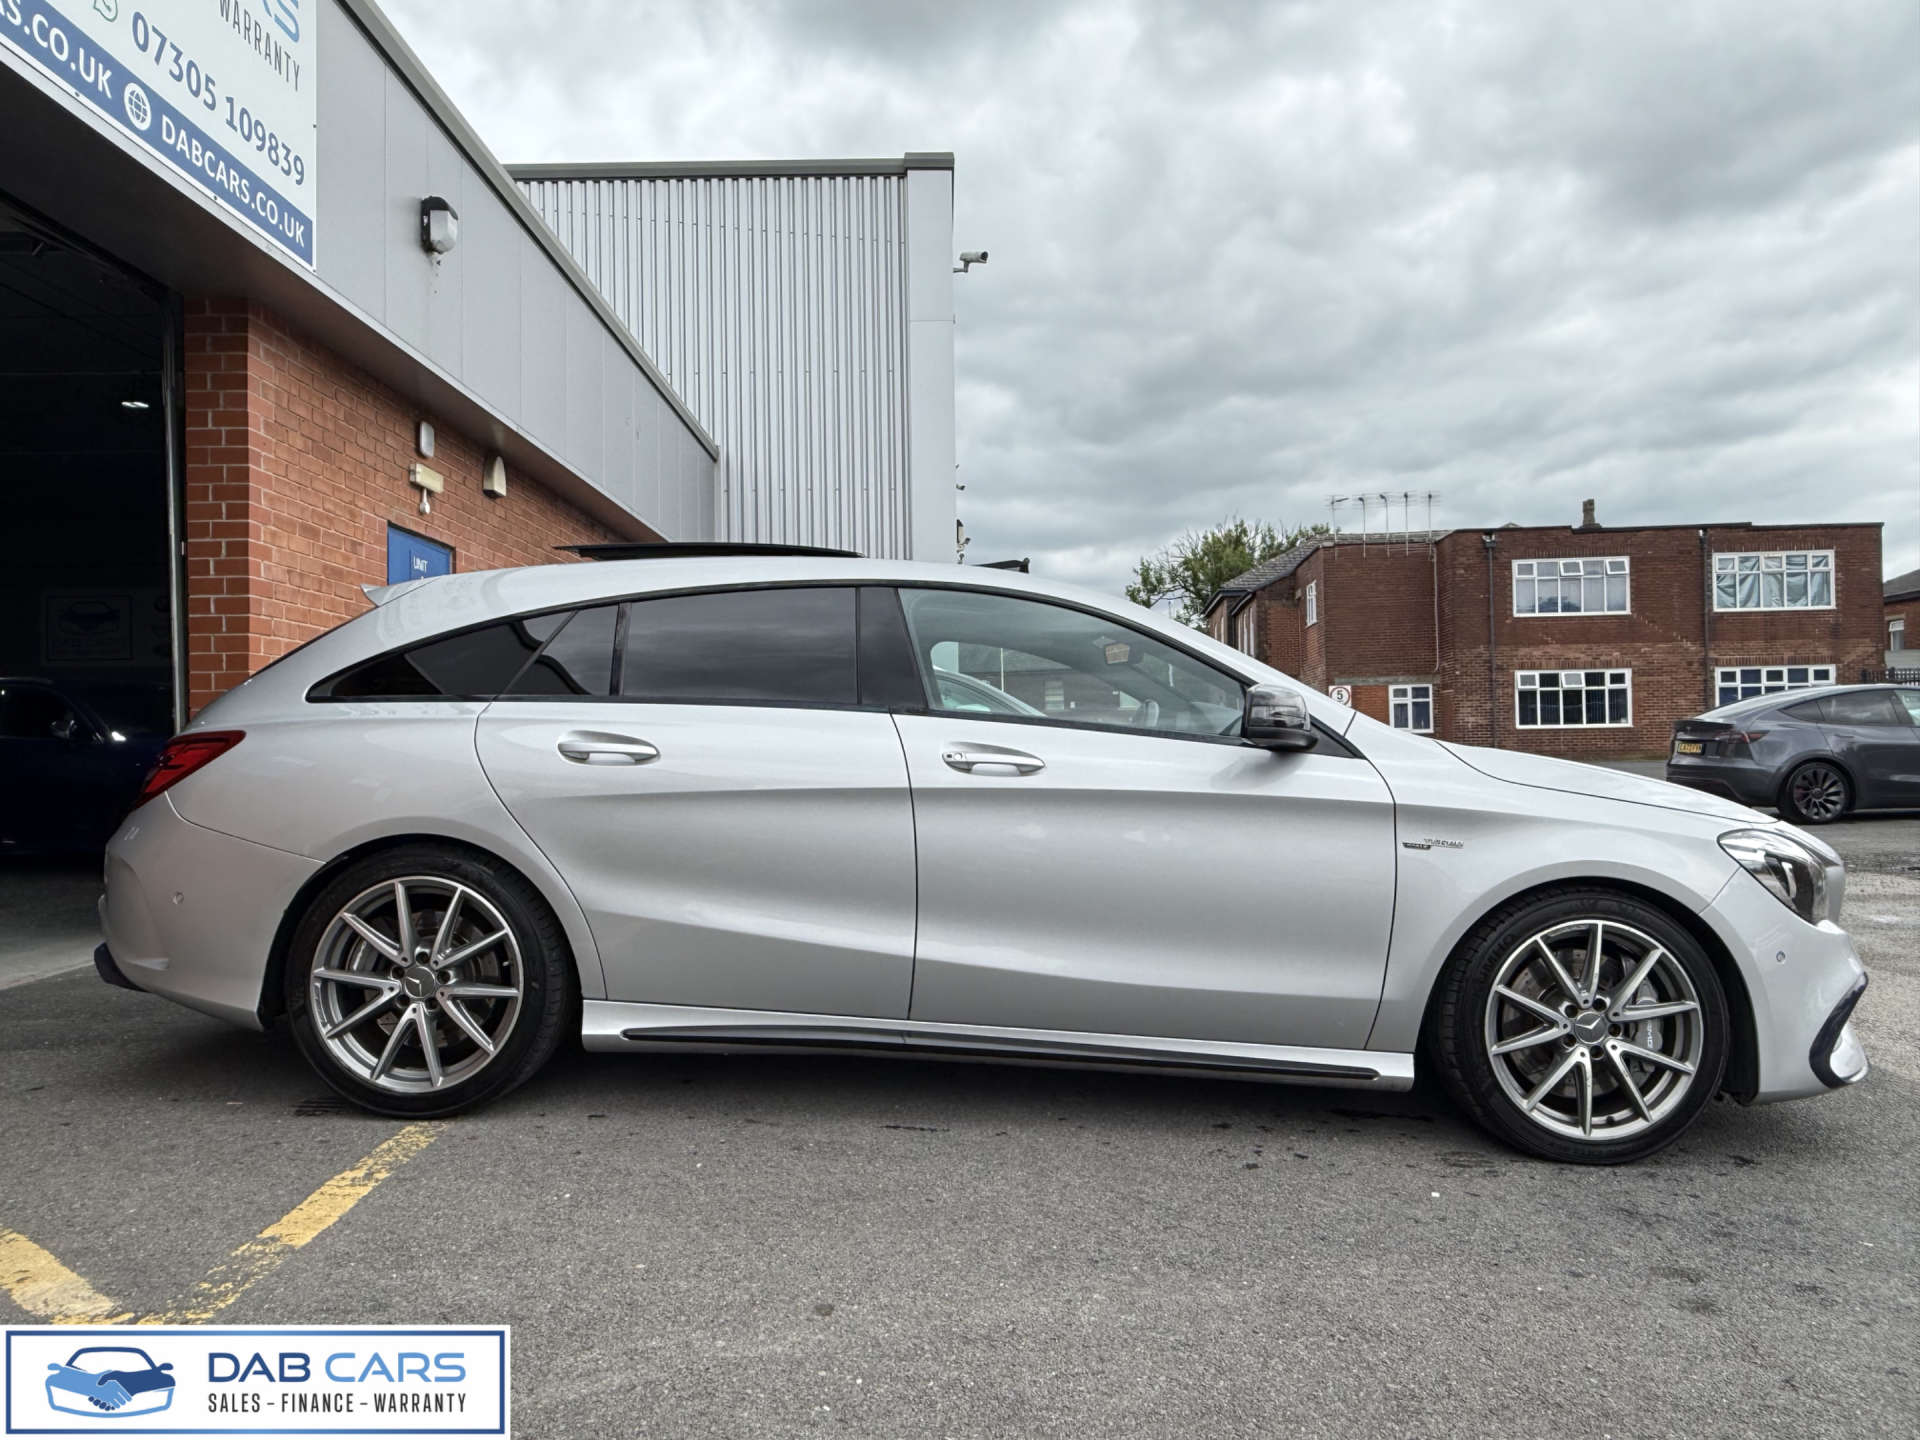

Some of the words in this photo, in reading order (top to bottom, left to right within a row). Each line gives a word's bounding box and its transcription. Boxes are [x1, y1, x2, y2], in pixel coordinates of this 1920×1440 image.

[132, 11, 217, 111] 07305
[225, 96, 305, 186] 109839
[219, 0, 300, 92] WARRANTY
[162, 114, 305, 248] DABCARS.CO.UK
[1336, 690, 1344, 700] 5
